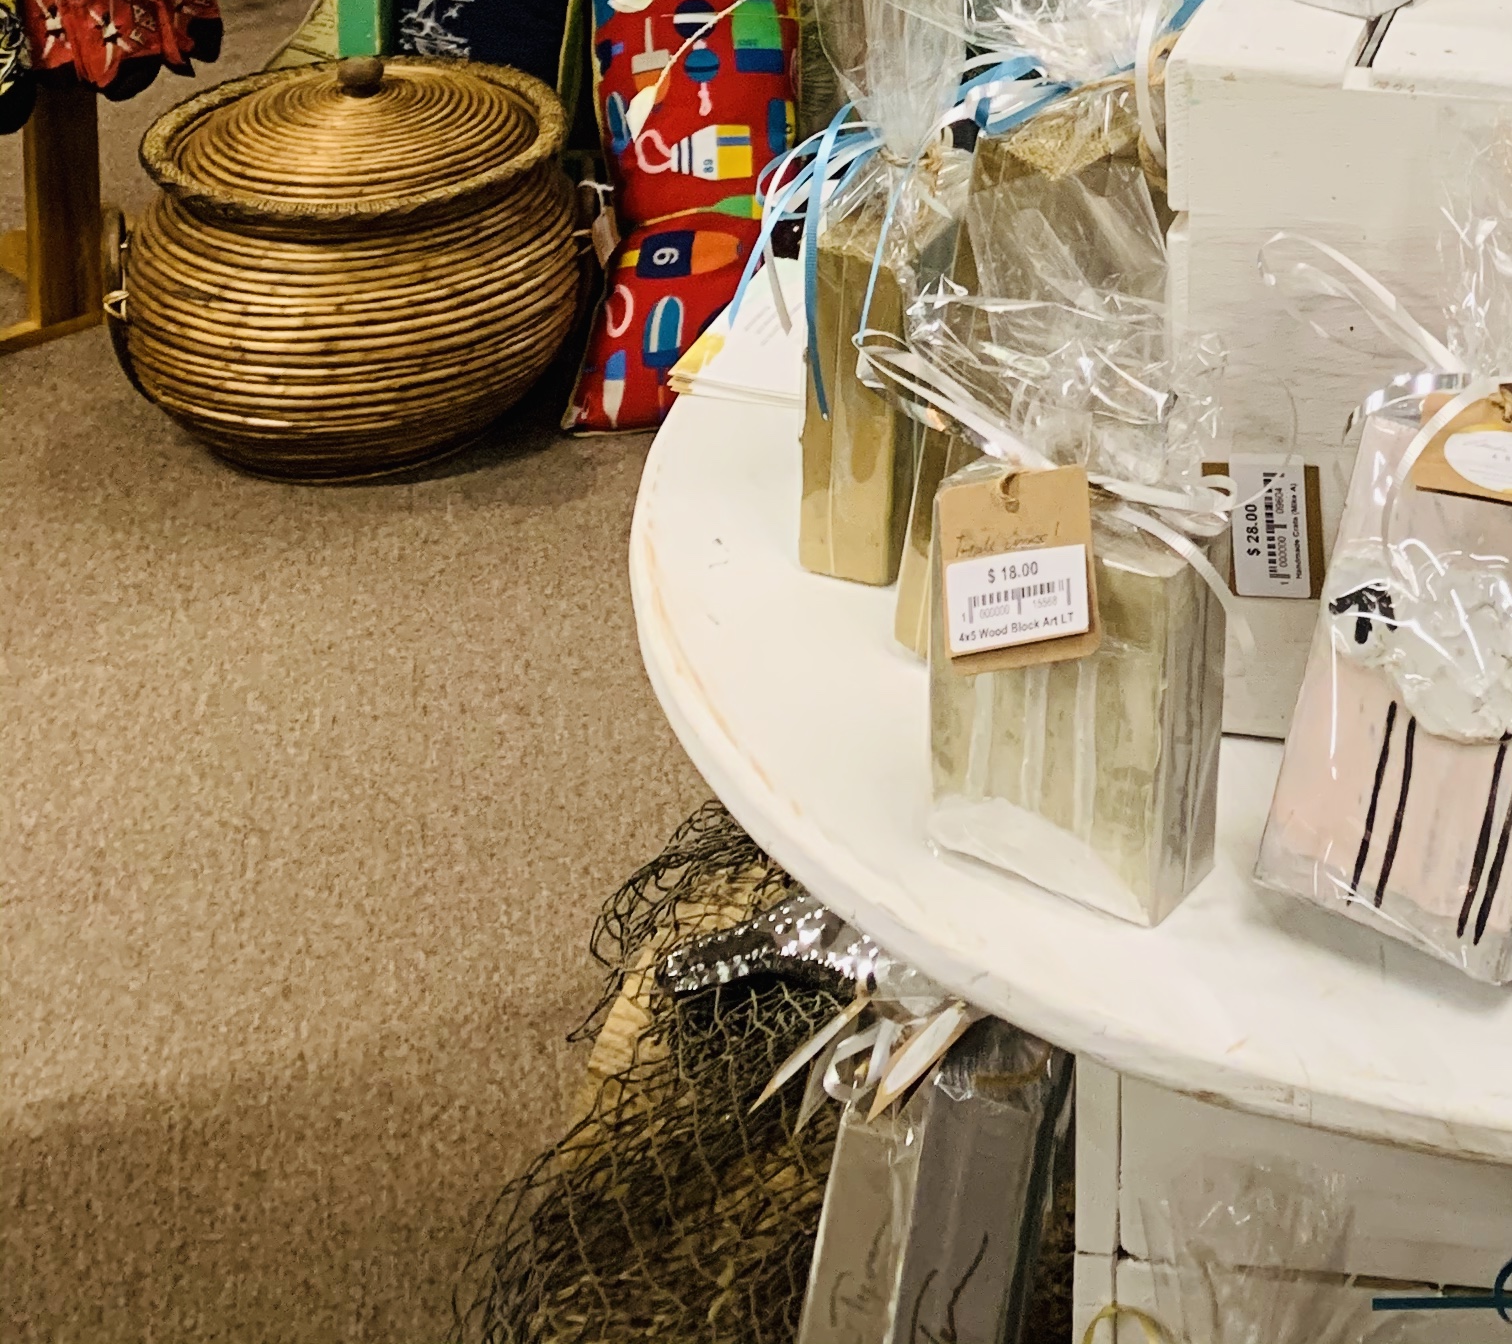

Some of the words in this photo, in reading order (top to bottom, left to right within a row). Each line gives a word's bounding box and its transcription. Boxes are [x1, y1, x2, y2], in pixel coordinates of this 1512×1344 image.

[1245, 503, 1260, 544] 28.00
[1247, 547, 1261, 557] $
[1292, 539, 1303, 579] Handmade
[987, 569, 996, 584] $
[1001, 561, 1039, 581] 18.00
[958, 630, 977, 643] 4x5
[979, 623, 1009, 640] Wood
[1011, 618, 1040, 634] Block
[1043, 615, 1059, 627] Art
[1061, 612, 1074, 625] LT
